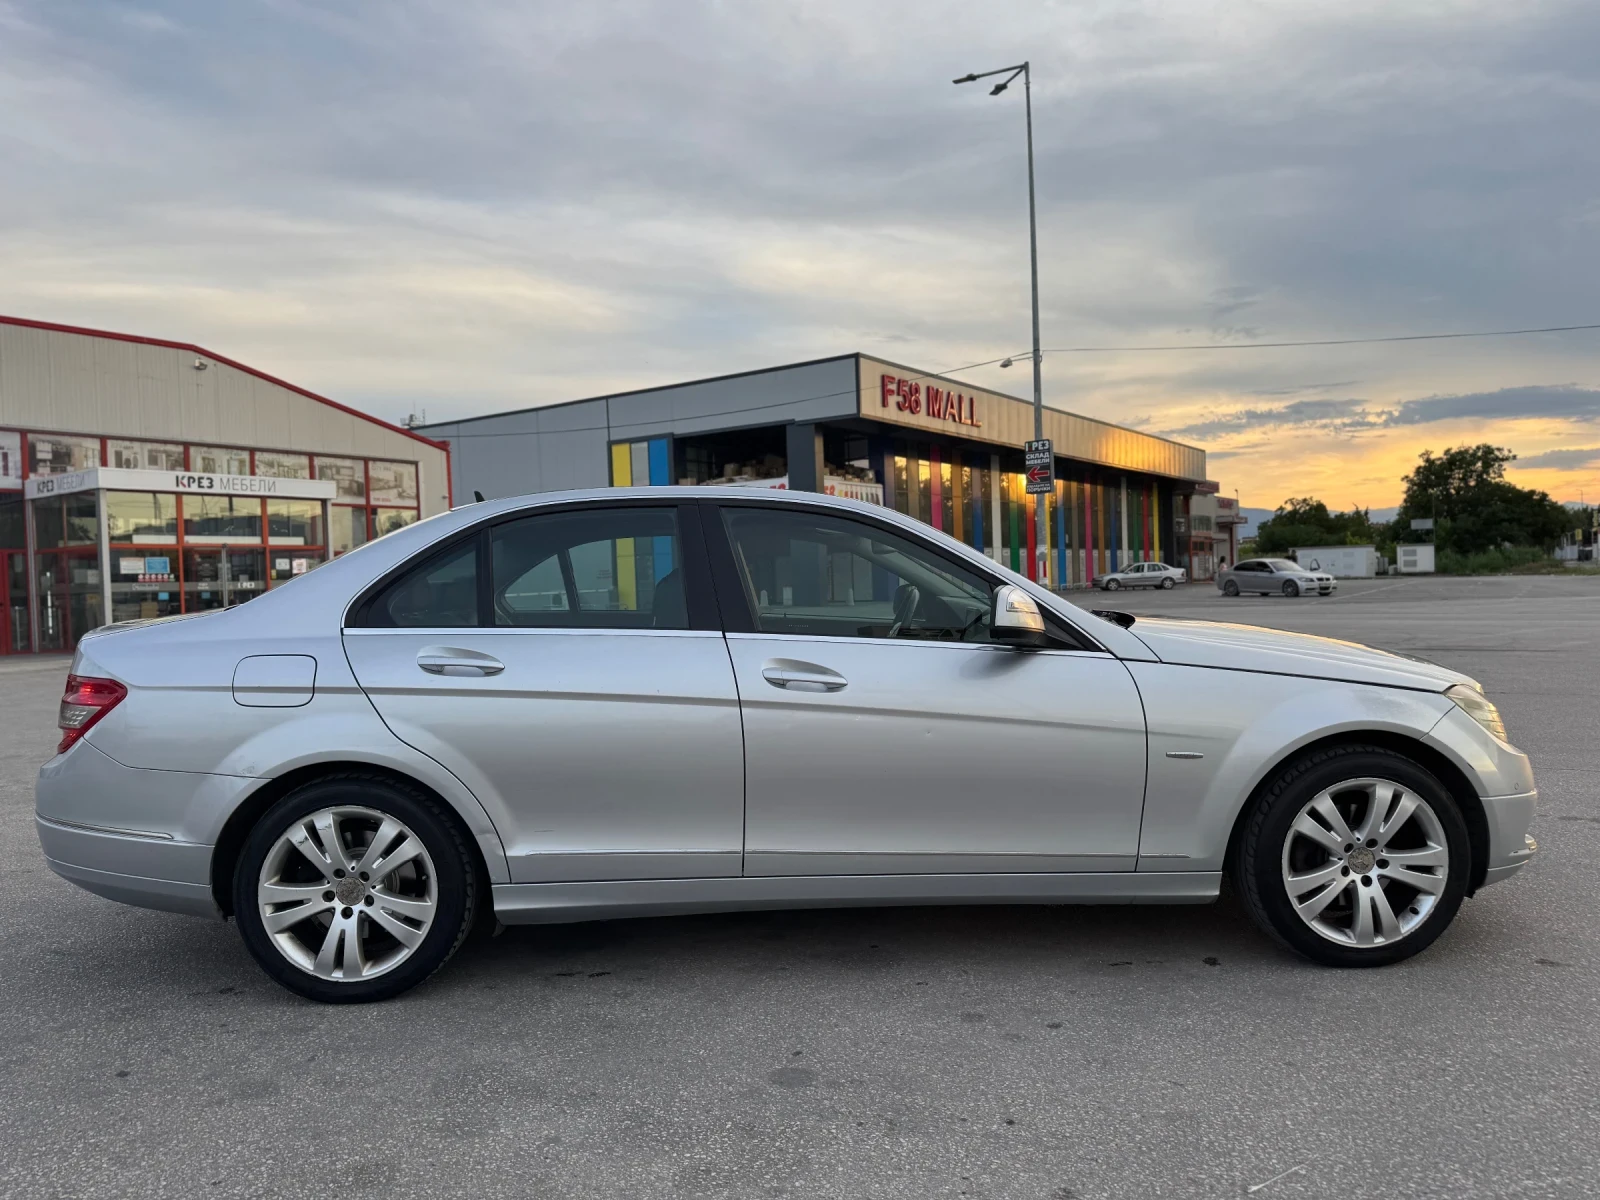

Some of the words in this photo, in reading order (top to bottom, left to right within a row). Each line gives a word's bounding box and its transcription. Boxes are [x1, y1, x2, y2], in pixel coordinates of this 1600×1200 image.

[882, 374, 921, 414] F58
[926, 385, 982, 427] MALL
[37, 479, 54, 494] КРЕЗ
[175, 475, 214, 489] КРЕЗ
[220, 477, 276, 493] МЕБЕЛИ
